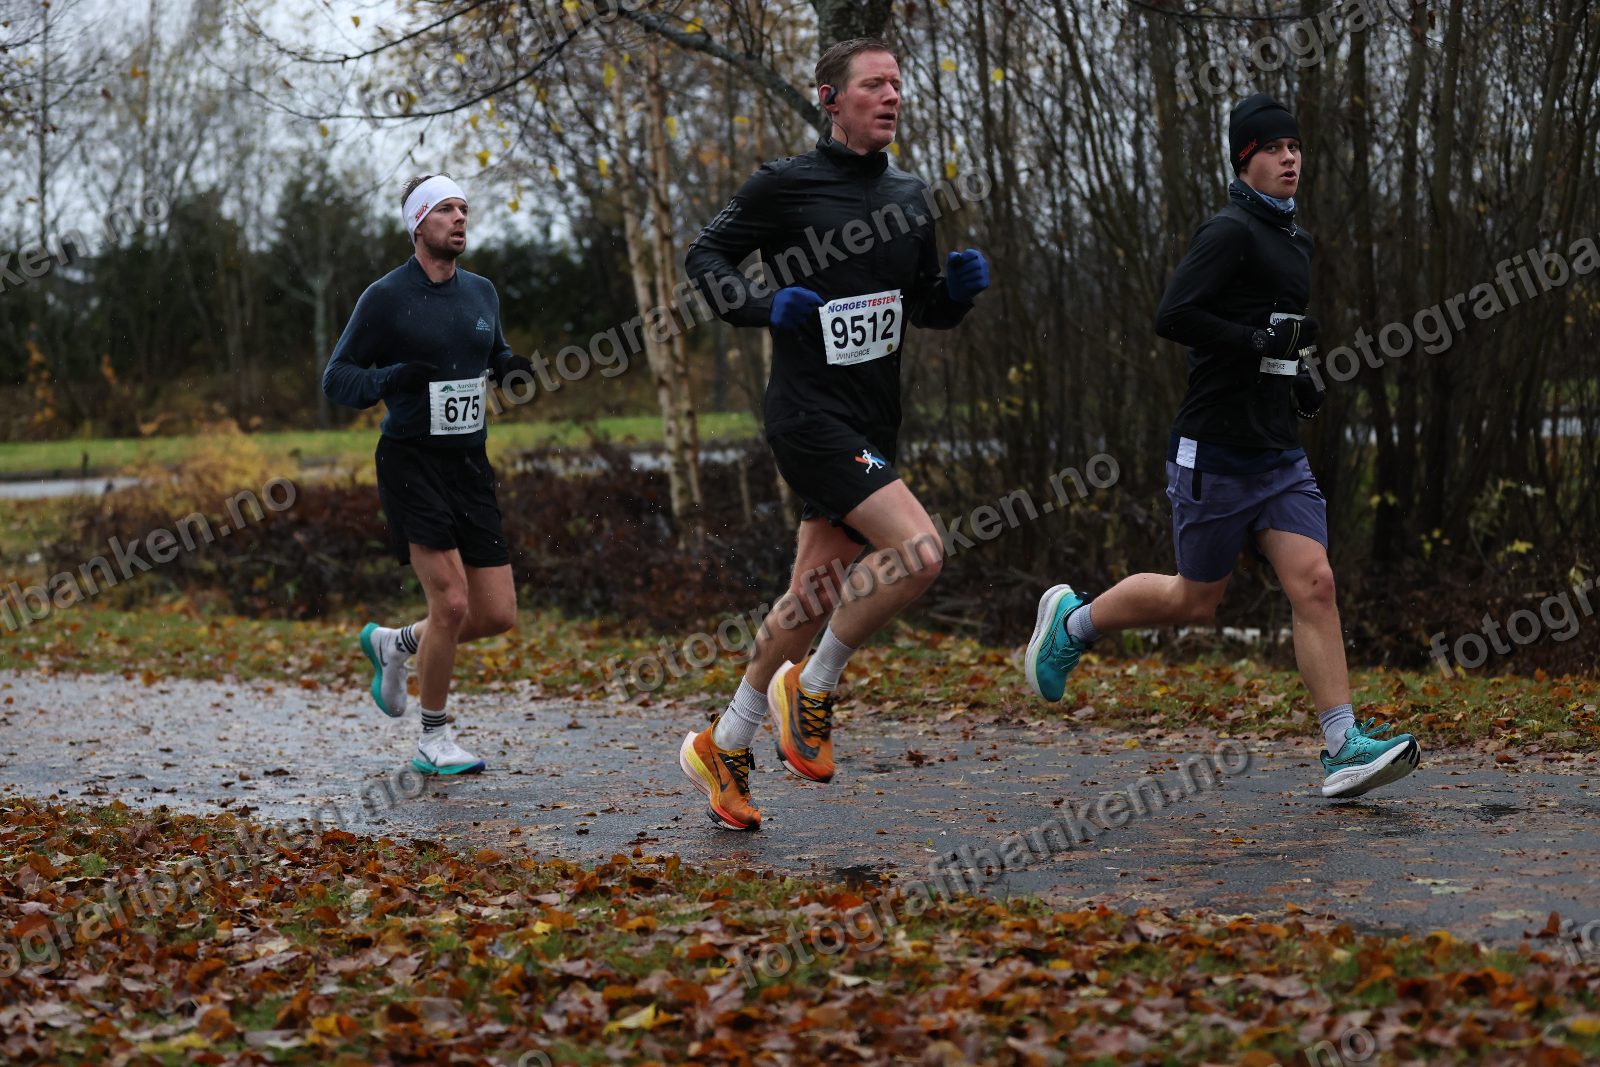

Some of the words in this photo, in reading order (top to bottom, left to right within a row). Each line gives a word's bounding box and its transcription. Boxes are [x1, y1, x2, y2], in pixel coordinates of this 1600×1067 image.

[827, 295, 896, 313] NORGESTESTEN
[831, 308, 896, 350] 9512
[836, 348, 871, 360] WINFORCE
[444, 395, 480, 424] 675
